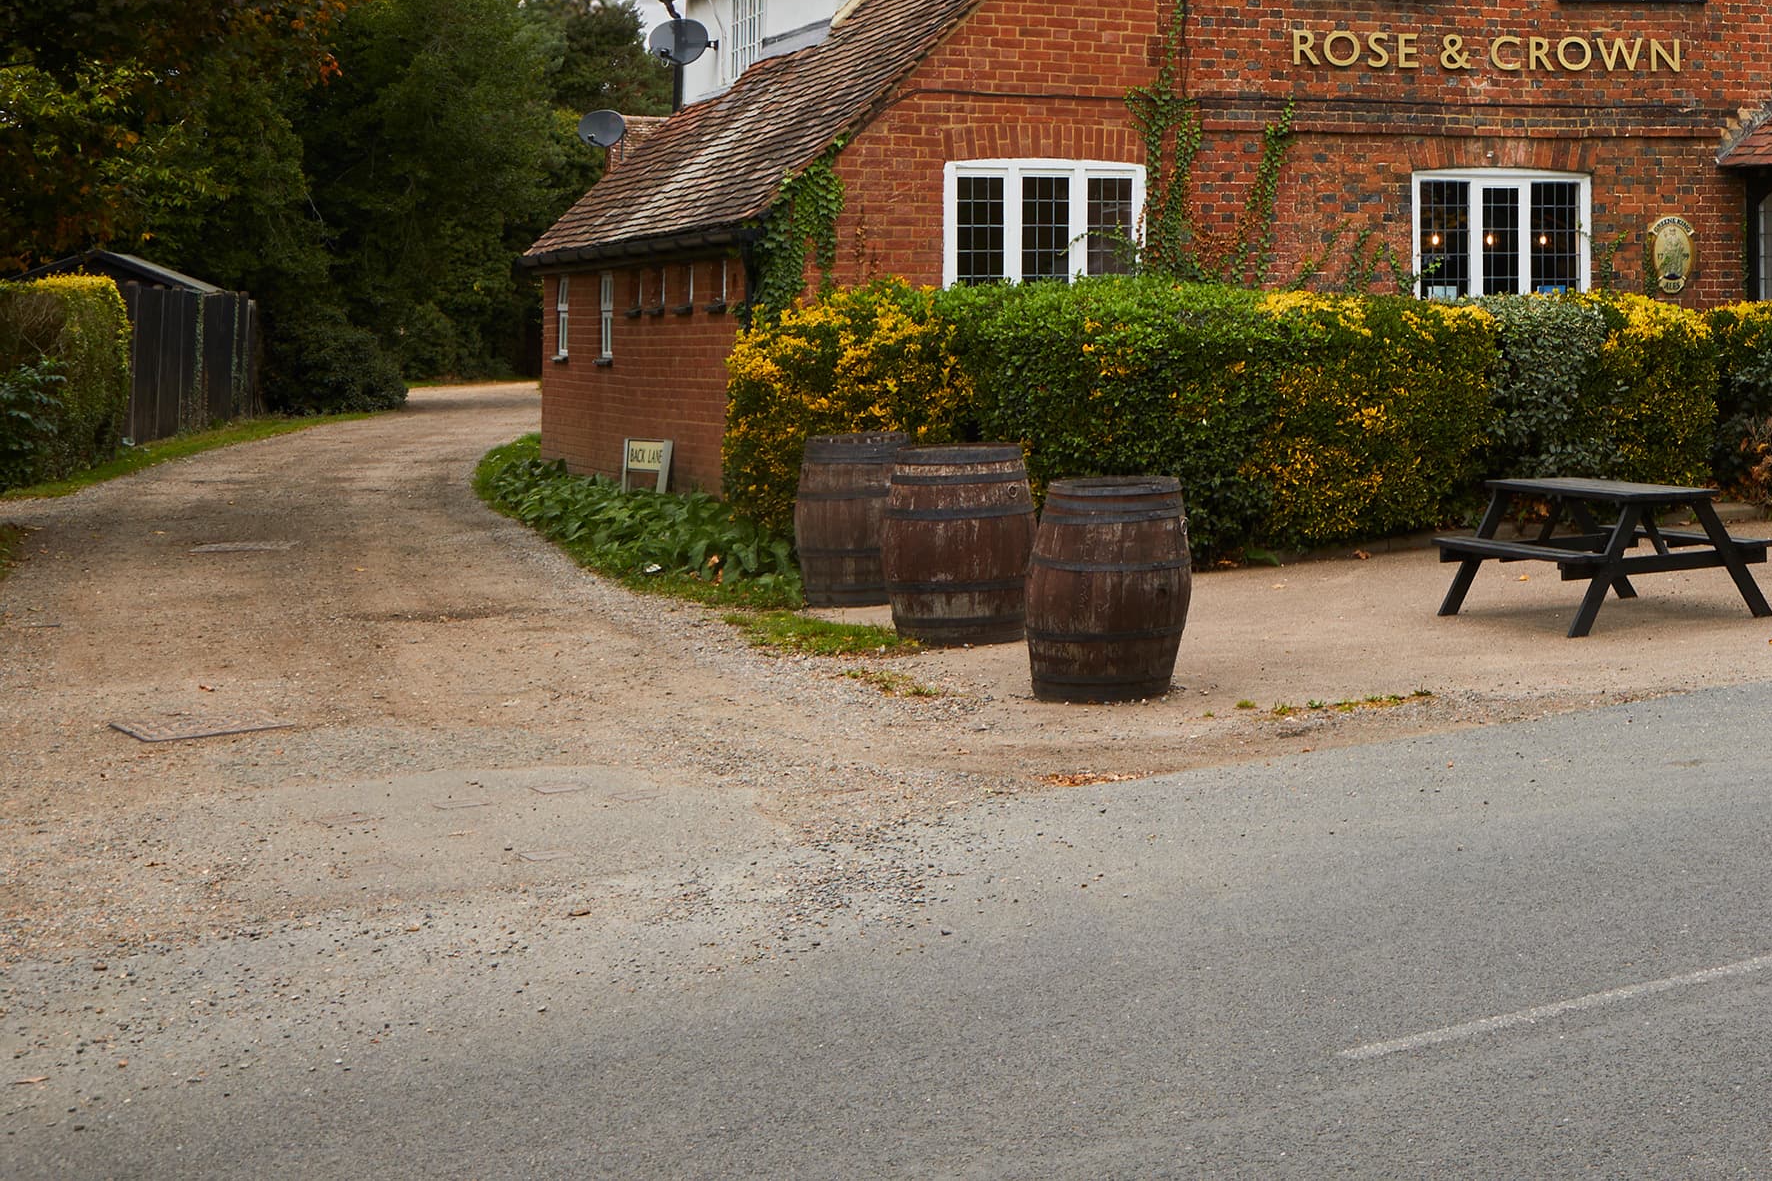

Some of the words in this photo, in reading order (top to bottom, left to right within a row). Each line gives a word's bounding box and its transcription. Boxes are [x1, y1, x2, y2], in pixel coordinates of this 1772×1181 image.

[1292, 30, 1420, 68] ROSE
[1439, 34, 1472, 70] &
[1490, 35, 1682, 73] CROWN
